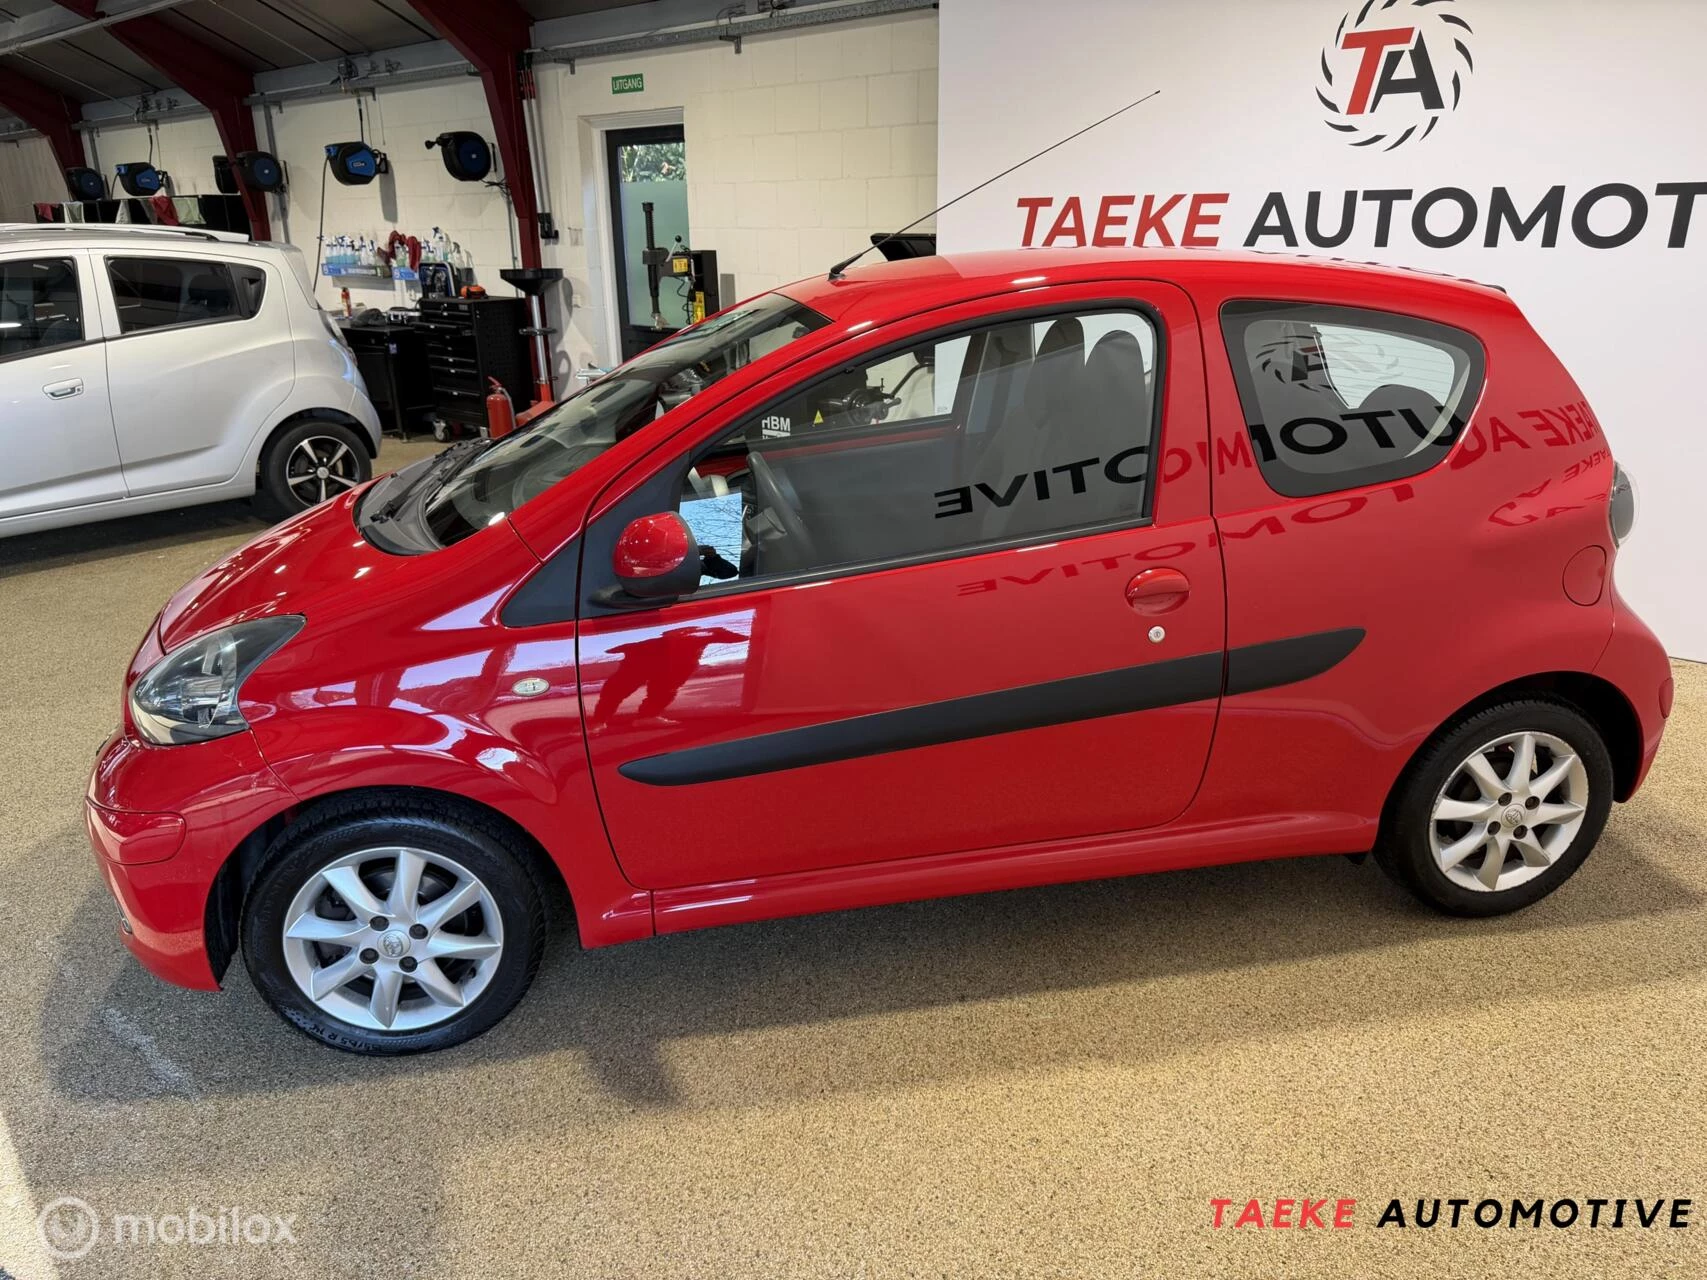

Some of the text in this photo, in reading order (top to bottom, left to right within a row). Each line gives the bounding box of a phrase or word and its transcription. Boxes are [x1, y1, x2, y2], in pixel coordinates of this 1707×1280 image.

[612, 77, 642, 91] UITGANG
[1343, 28, 1445, 115] TA
[1017, 182, 1707, 249] TAEKE AUTOMOT
[761, 415, 791, 432] HBM
